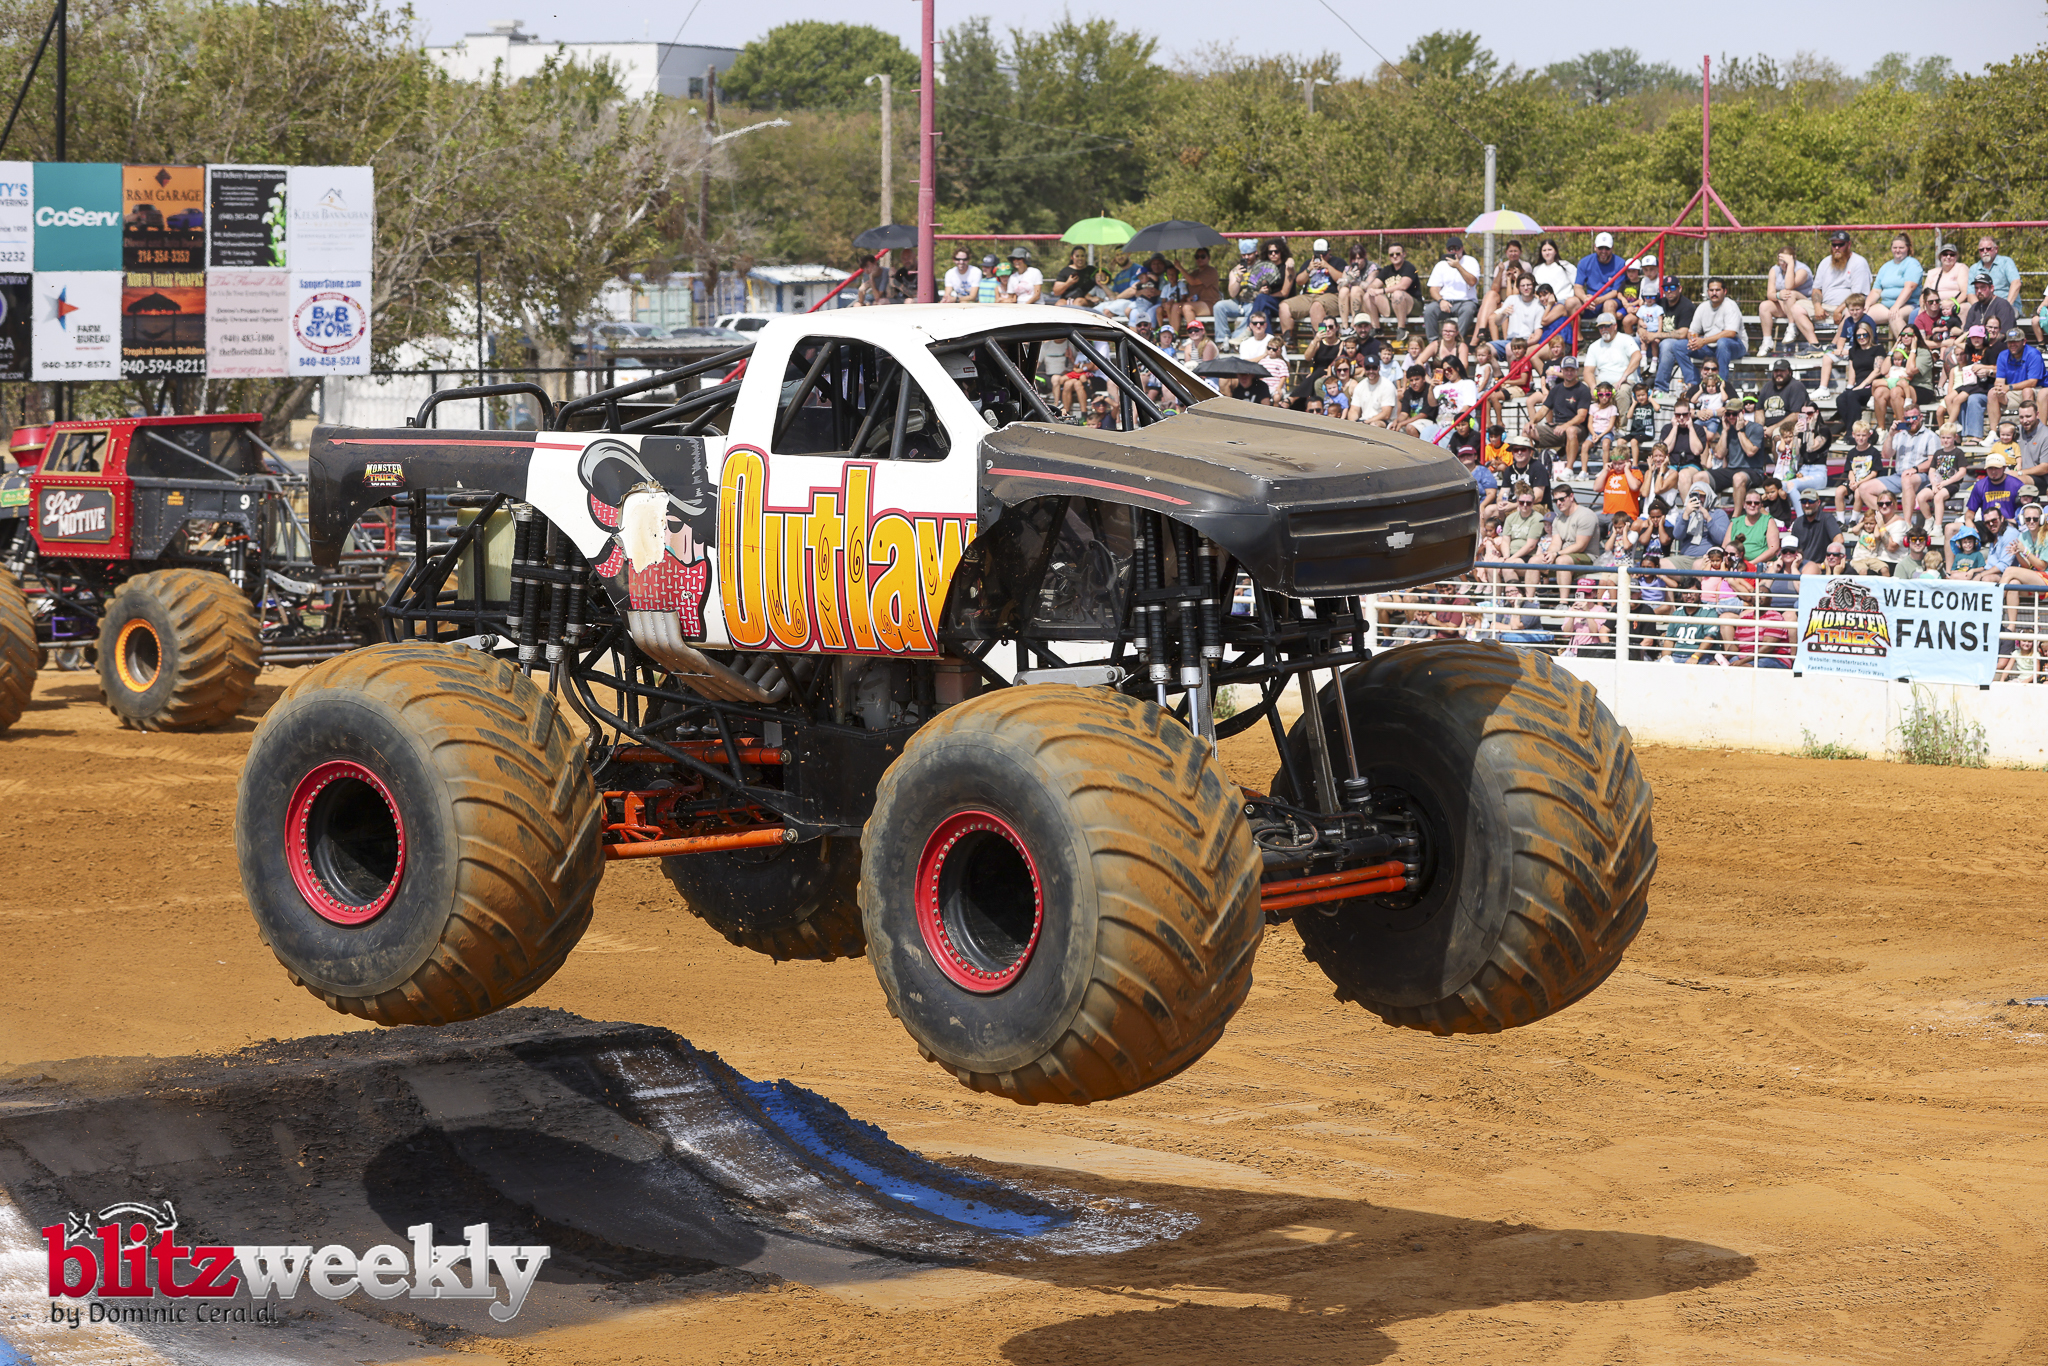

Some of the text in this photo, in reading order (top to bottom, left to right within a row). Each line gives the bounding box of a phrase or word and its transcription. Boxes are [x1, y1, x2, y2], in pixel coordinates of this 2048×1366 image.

[126, 190, 201, 201] R&M GARAGE
[36, 206, 120, 228] CoServ
[76, 335, 110, 343] BUREAU
[123, 347, 153, 357] Tropical
[120, 359, 206, 374] 940-594-8211
[364, 463, 404, 480] MONSTER
[240, 494, 250, 510] 9
[58, 506, 106, 537] MOTIVE
[718, 446, 977, 654] Outlaw
[1883, 588, 1993, 612] WELCOME
[1804, 609, 1890, 642] MONSTER
[1816, 629, 1879, 646] TRUCK
[1896, 619, 1990, 652] FANS!
[1820, 644, 1876, 654] WARS
[1832, 658, 1878, 667] monstertrucks.fun
